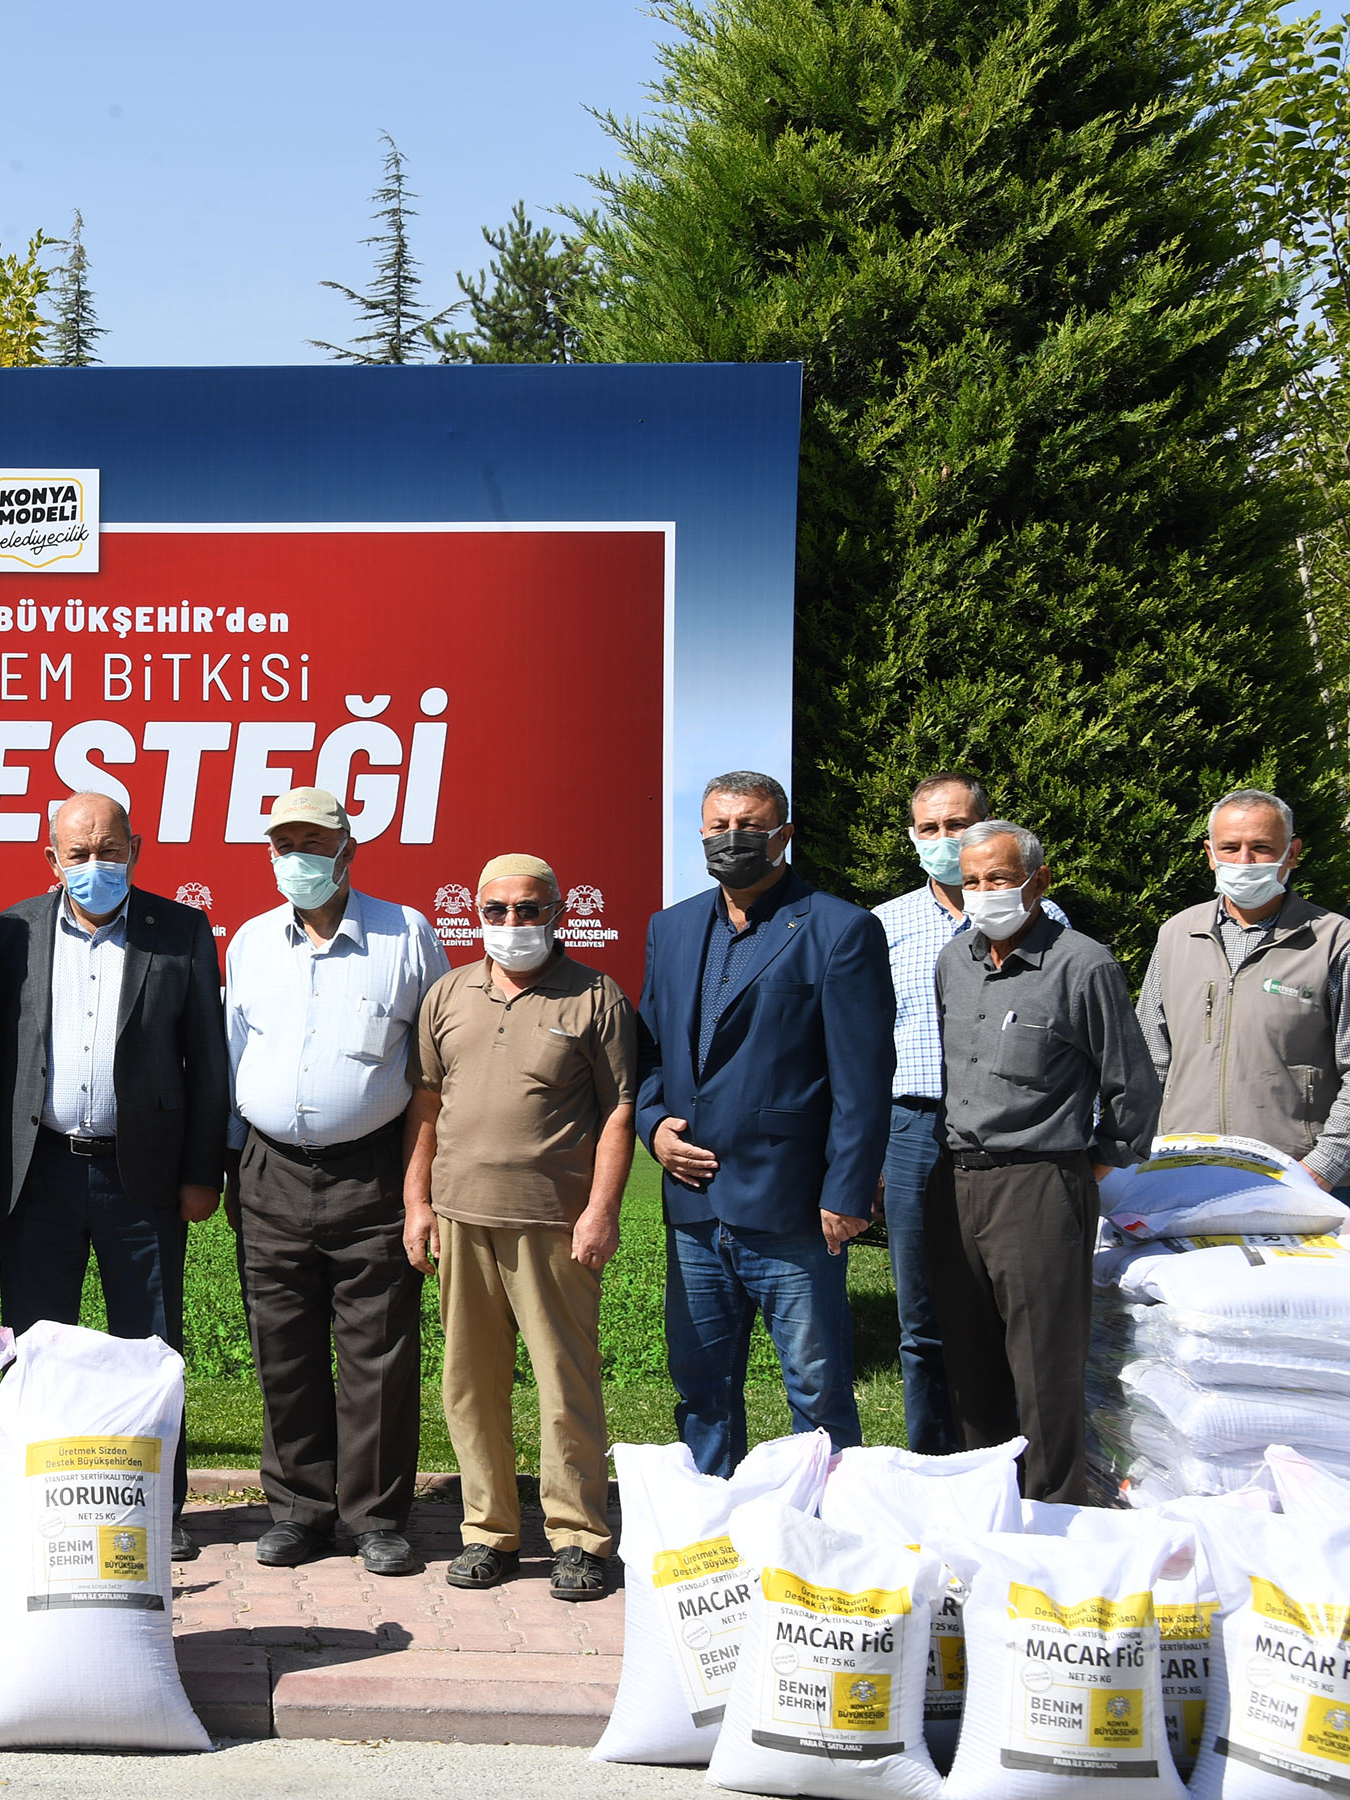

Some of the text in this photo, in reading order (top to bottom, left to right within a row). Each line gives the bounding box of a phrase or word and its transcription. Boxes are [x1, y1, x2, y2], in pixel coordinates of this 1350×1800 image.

[0, 486, 77, 507] KONYA
[437, 918, 470, 926] KONYA
[568, 919, 602, 927] KONYA
[554, 928, 618, 940] BÜYÜKŞEHİR
[59, 1446, 127, 1456] Üretmek Sizden
[46, 1457, 142, 1468] Destek Büyükşehir'den
[46, 1486, 146, 1507] KORUNGA
[684, 1546, 719, 1565] Üretmek
[673, 1566, 702, 1577] Destek
[678, 1584, 751, 1620] MACAR
[722, 1612, 748, 1625] NET 25
[935, 1623, 946, 1631] 25
[777, 1622, 853, 1651] MACAR
[1026, 1638, 1110, 1667] MACAR
[1255, 1634, 1336, 1677] MACAR
[813, 1655, 855, 1667] NET 25 KG
[705, 1660, 737, 1680] ŞEHR
[1068, 1671, 1112, 1683] NET 25 KG
[1178, 1687, 1188, 1695] 25
[1190, 1686, 1202, 1695] KG
[1308, 1679, 1319, 1689] 25
[1322, 1684, 1335, 1693] KG
